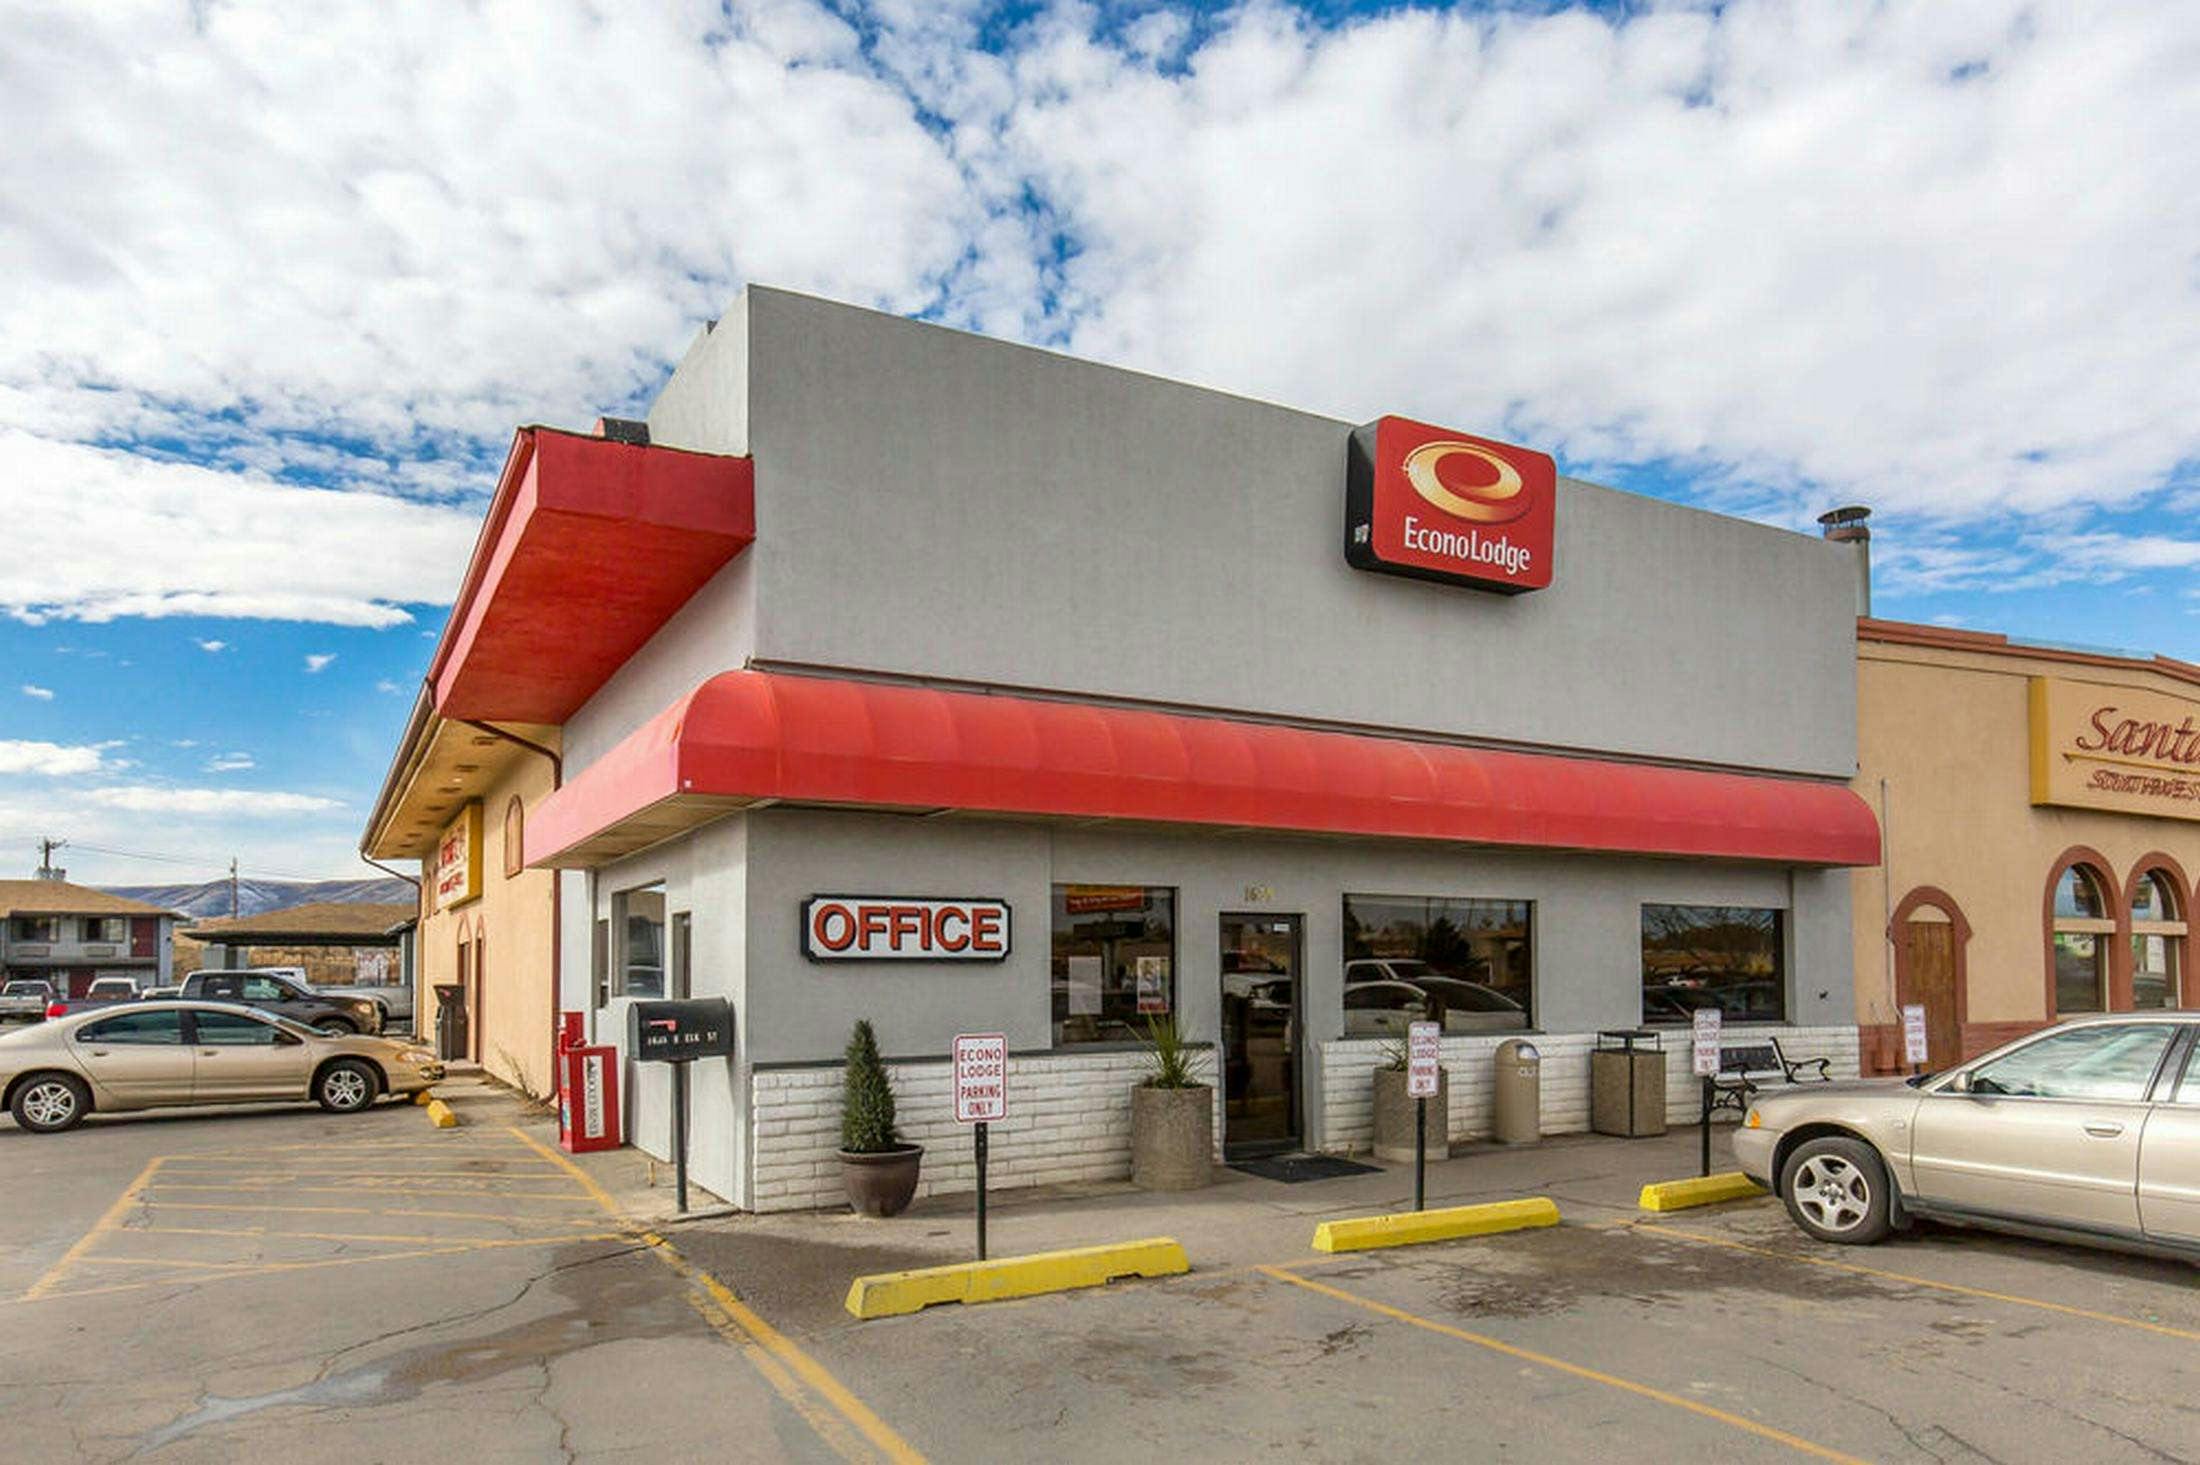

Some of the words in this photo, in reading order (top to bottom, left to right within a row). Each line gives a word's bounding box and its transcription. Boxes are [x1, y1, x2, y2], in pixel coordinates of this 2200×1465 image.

[1404, 515, 1531, 576] EconoLodge
[813, 903, 1002, 952] OFFICE
[960, 1048, 1002, 1062] ECONO
[960, 1064, 1001, 1079] LODGE
[960, 1084, 1001, 1099] PARKING
[967, 1101, 994, 1116] ONLY
